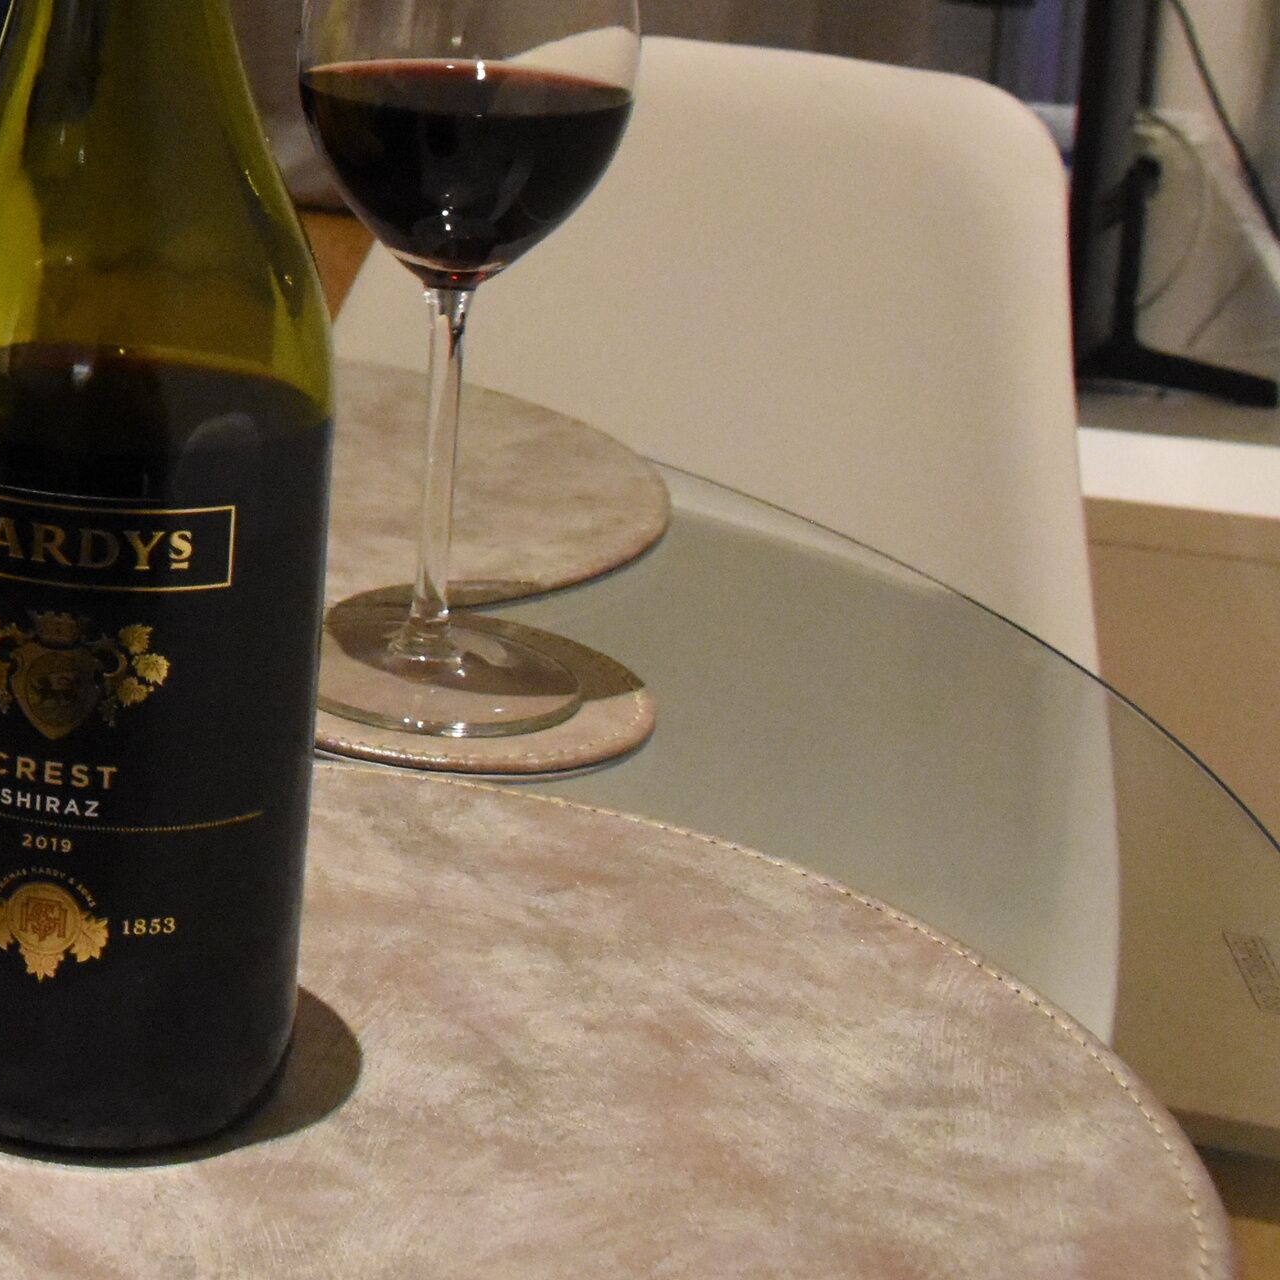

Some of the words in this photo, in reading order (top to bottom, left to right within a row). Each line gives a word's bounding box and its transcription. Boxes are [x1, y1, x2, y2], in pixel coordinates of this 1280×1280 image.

[0, 787, 100, 817] SHIRAZ
[21, 833, 73, 853] 2019
[121, 917, 177, 935] 1853
